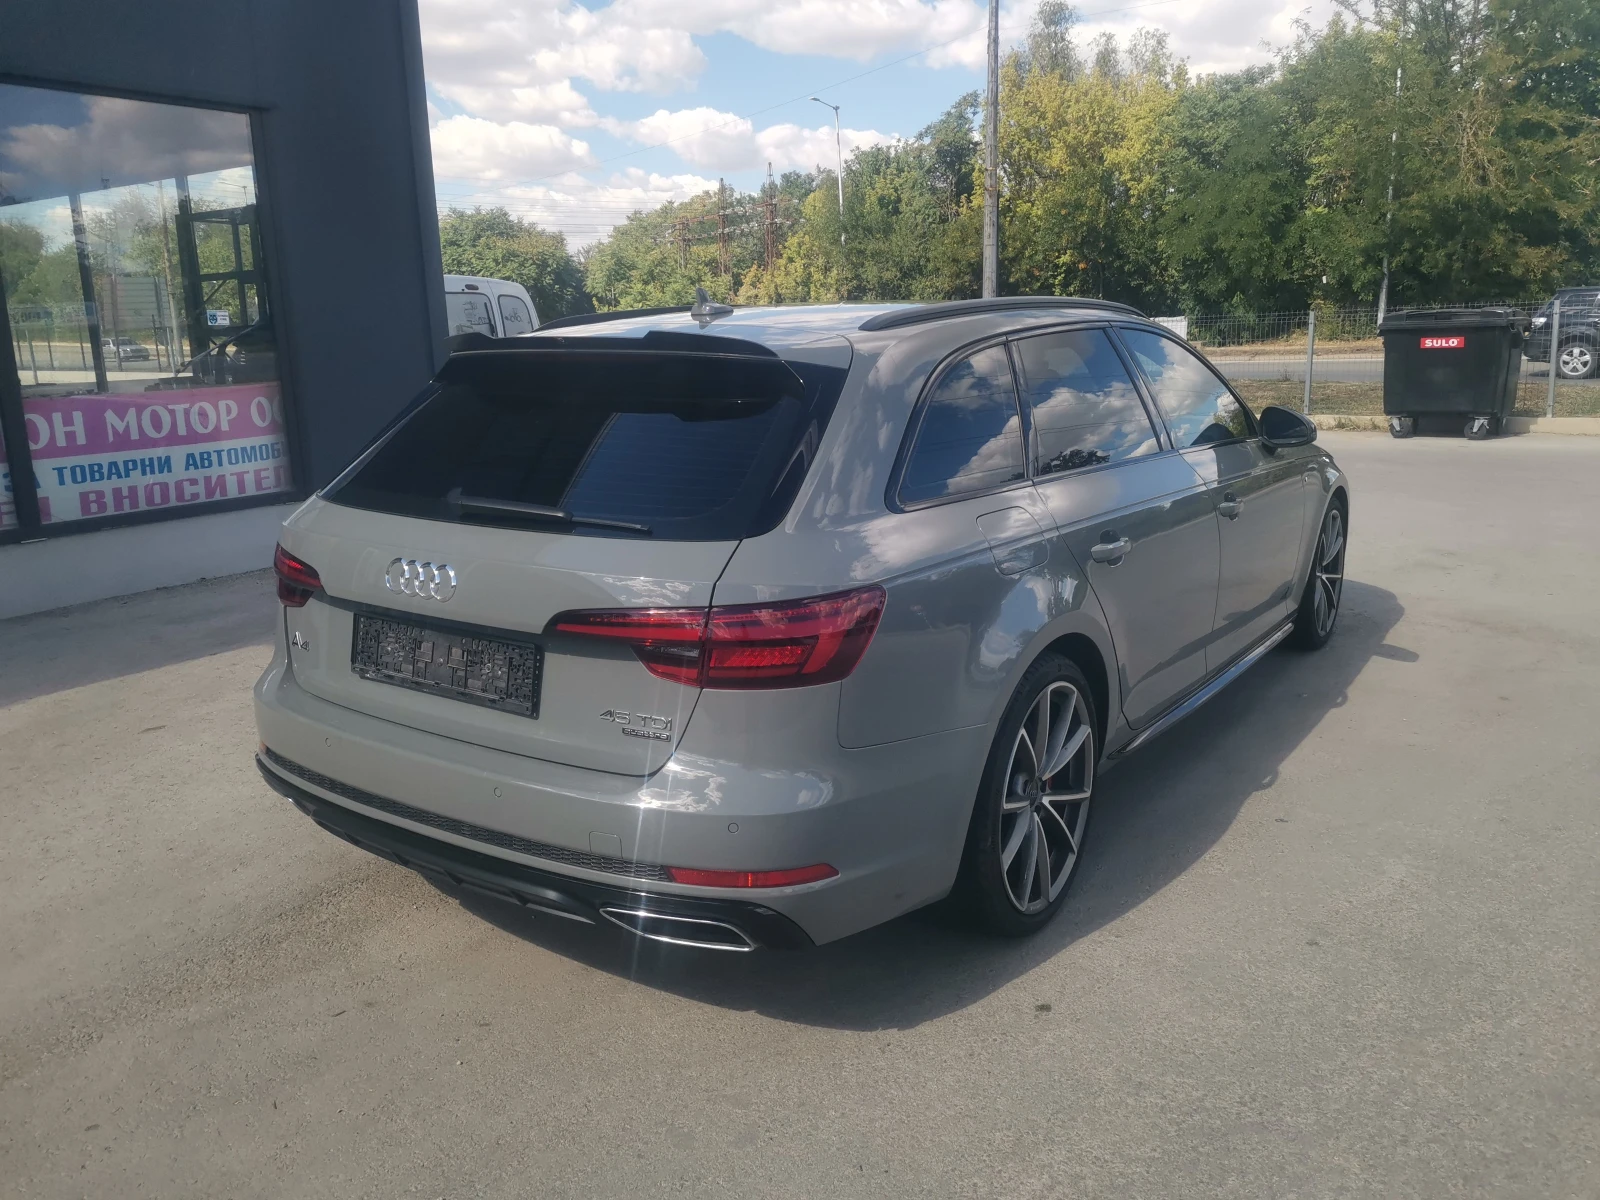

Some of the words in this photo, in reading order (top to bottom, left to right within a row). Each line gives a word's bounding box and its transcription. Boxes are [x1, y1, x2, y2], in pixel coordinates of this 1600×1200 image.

[1424, 338, 1458, 347] SULO
[104, 400, 238, 443] МОТОР
[52, 454, 173, 487] ТОВАРНИ
[292, 631, 310, 652] A4
[600, 709, 631, 725] 45
[636, 713, 673, 731] TDI
